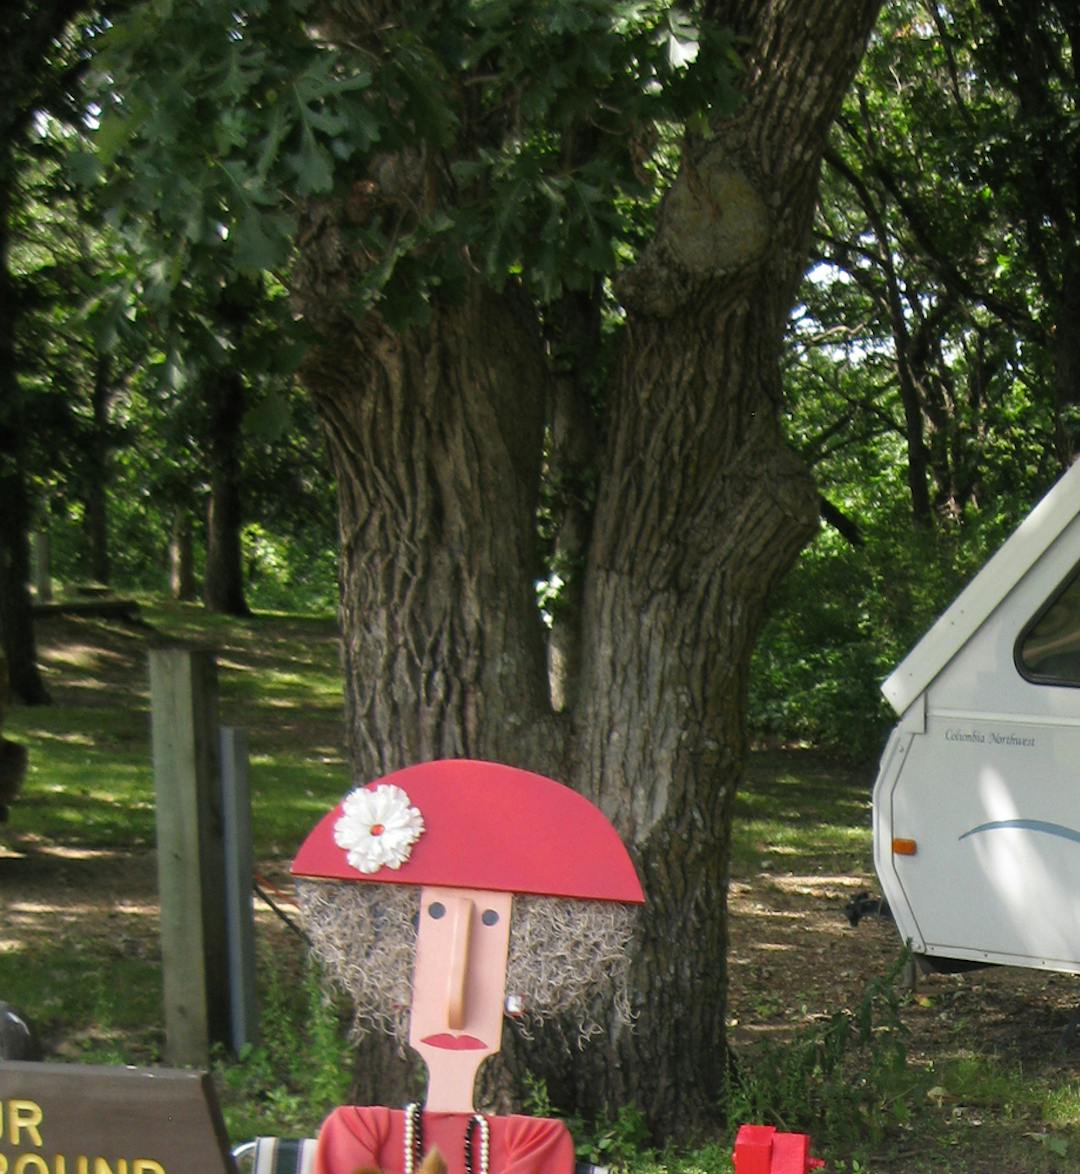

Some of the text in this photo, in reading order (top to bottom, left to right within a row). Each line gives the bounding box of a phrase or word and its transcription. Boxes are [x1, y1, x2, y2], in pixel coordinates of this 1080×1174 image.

[944, 729, 1035, 747] Columbia Northwest
[0, 1099, 43, 1147] R
